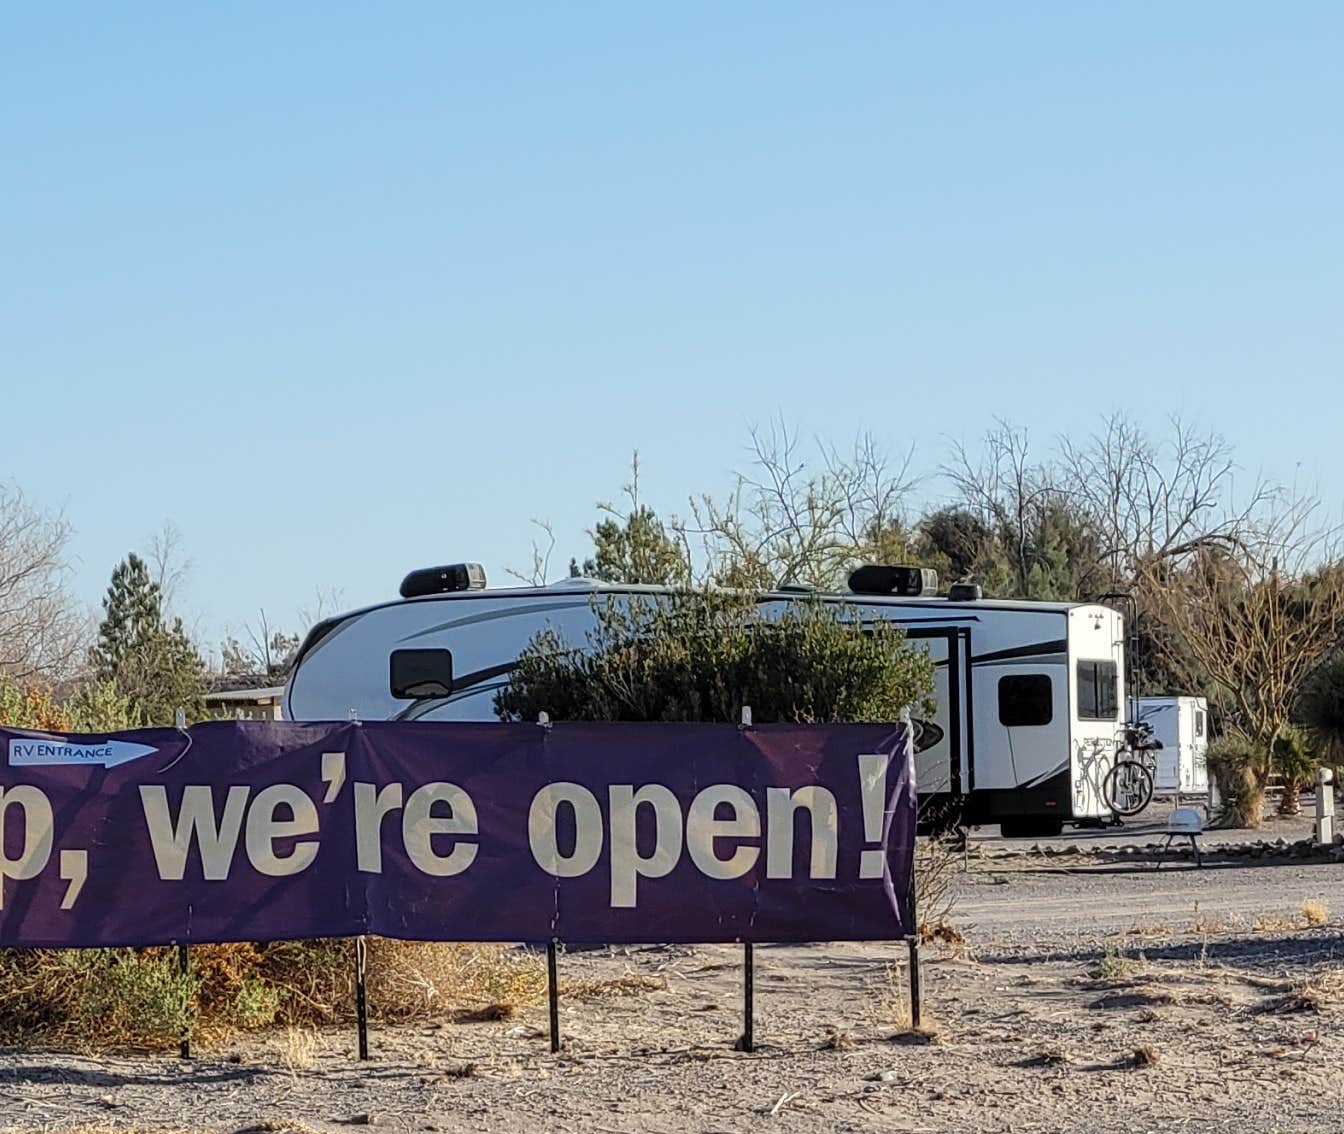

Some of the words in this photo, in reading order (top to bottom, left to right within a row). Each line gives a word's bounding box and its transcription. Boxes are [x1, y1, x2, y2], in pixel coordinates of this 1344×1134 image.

[14, 745, 34, 757] RV
[37, 745, 113, 759] ENTRANCE
[138, 752, 479, 881] we're
[528, 754, 889, 909] open!
